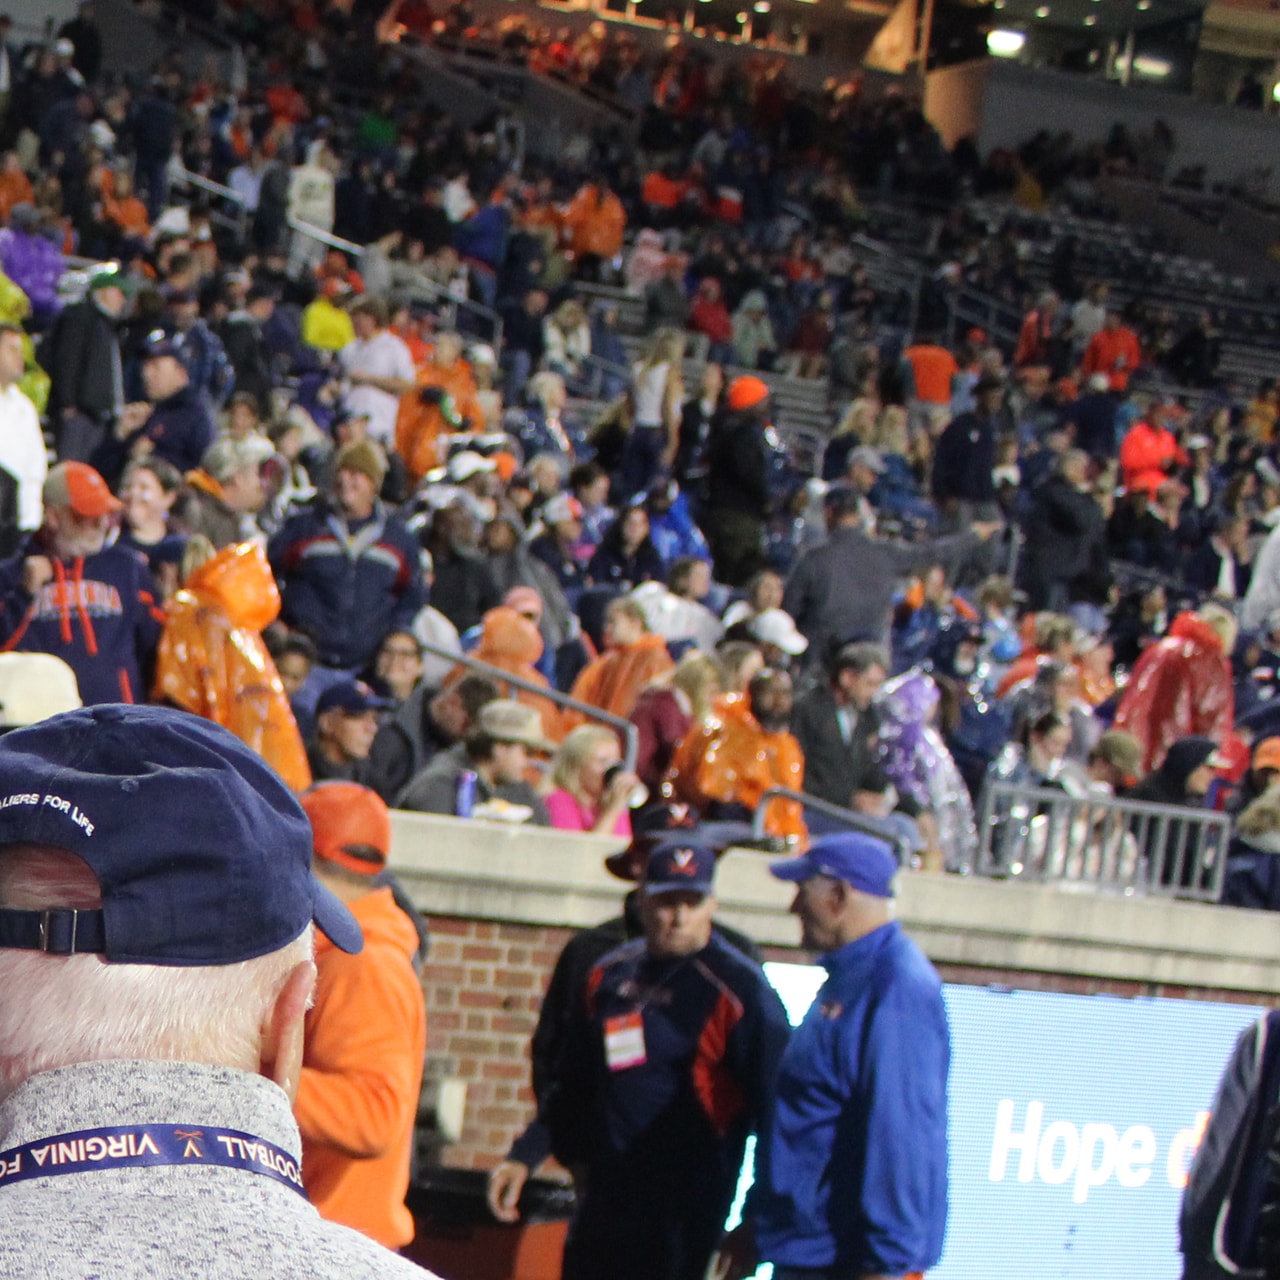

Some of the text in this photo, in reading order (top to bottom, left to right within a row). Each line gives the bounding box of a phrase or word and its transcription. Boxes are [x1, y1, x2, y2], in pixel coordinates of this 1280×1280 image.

[42, 794, 72, 814] FOR
[71, 806, 96, 837] LIFE
[30, 1132, 160, 1167] VIRGINIA
[989, 1098, 1157, 1204] Hope
